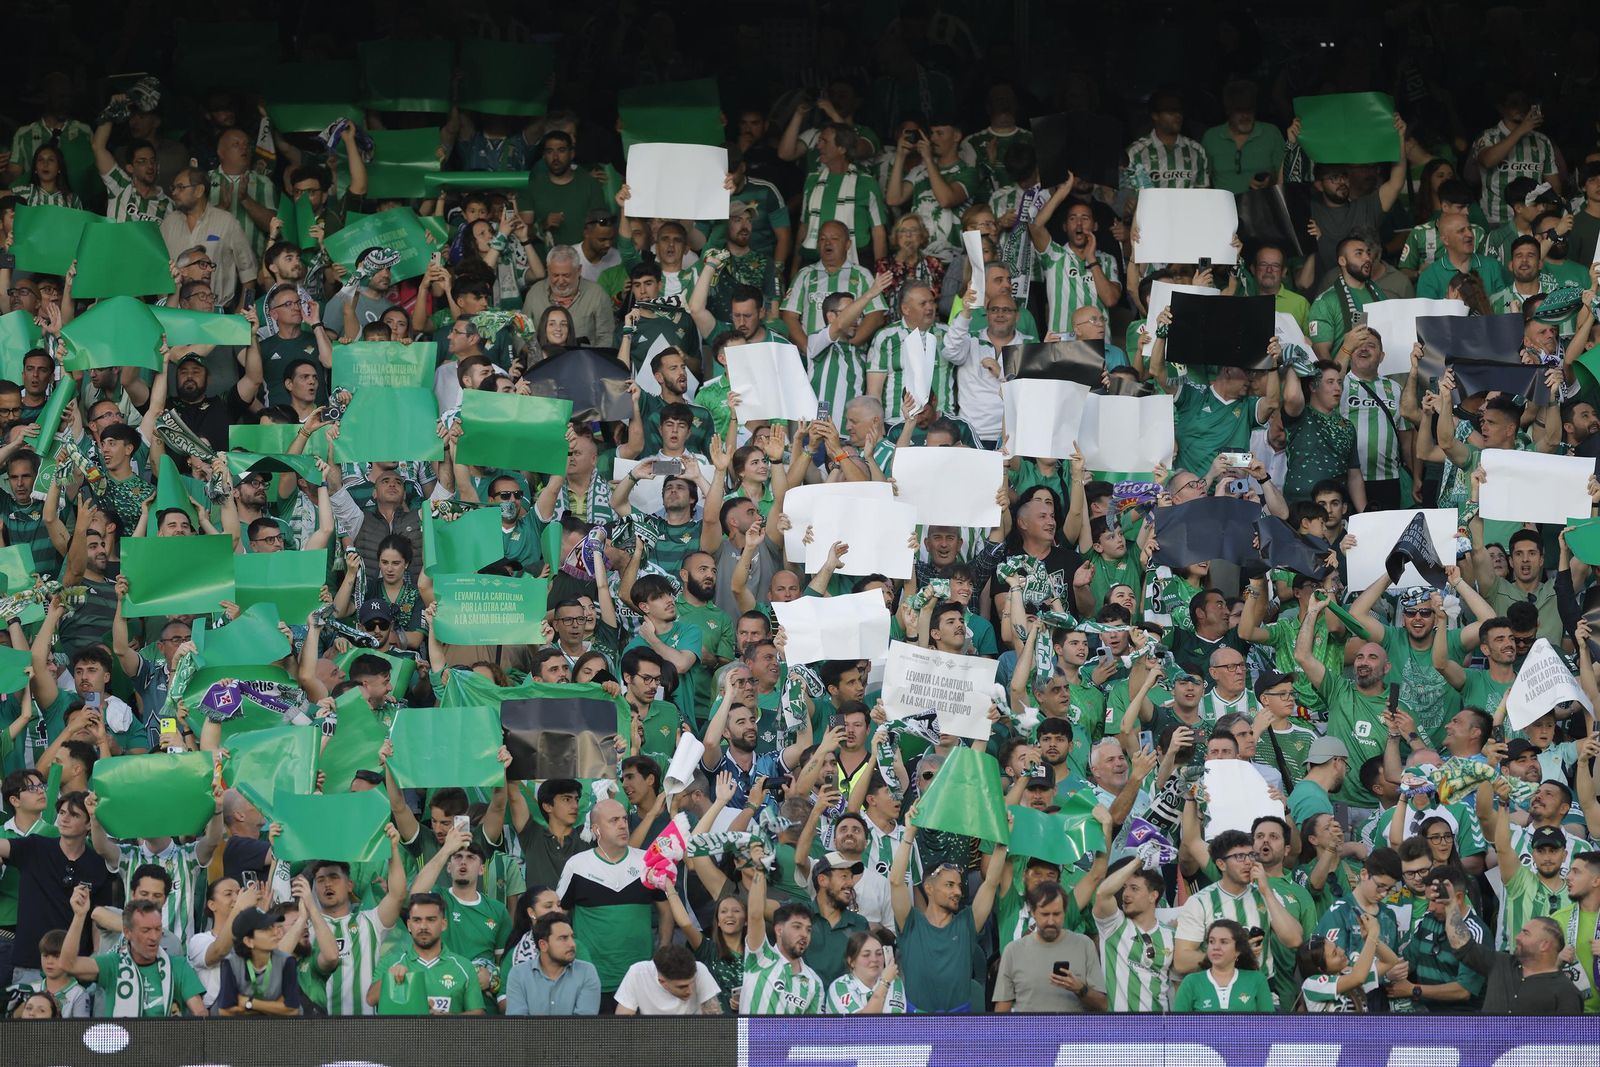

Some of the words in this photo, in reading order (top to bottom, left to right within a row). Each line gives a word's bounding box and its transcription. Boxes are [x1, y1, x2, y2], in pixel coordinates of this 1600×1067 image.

[1512, 163, 1541, 172] GREE
[454, 591, 480, 601] LEVANTA
[481, 591, 490, 601] LA
[490, 591, 524, 602] CARTULINA
[371, 601, 381, 610] NY
[461, 602, 474, 612] POR
[474, 602, 482, 612] LA
[483, 602, 499, 612] OTRA
[500, 602, 517, 612] CARA
[454, 613, 460, 625] A
[460, 613, 468, 625] LA
[468, 613, 490, 625] SALIDA
[490, 613, 501, 625] DEL
[502, 613, 525, 625] EQUIPO
[1520, 662, 1540, 682] LEVANTA
[1540, 659, 1549, 669] LA
[1526, 676, 1538, 689] POR
[1537, 672, 1546, 682] LA
[1545, 665, 1560, 680] OTRA
[905, 669, 931, 684] LEVANTA
[931, 674, 941, 686] LA
[940, 675, 974, 692] CARTULINA
[1525, 693, 1531, 703] A
[1530, 690, 1537, 701] LA
[1536, 679, 1555, 697] SALIDA
[1554, 675, 1566, 687] DEL
[910, 684, 922, 695] POR
[922, 686, 932, 697] LA
[931, 687, 948, 699] OTRA
[948, 690, 965, 703] CARA
[900, 694, 906, 704] A
[906, 695, 914, 706] LA
[914, 697, 937, 710] SALIDA
[937, 700, 948, 712] DEL
[949, 702, 972, 716] EQUIPO
[1351, 731, 1377, 747] nwork
[783, 992, 807, 1009] REE
